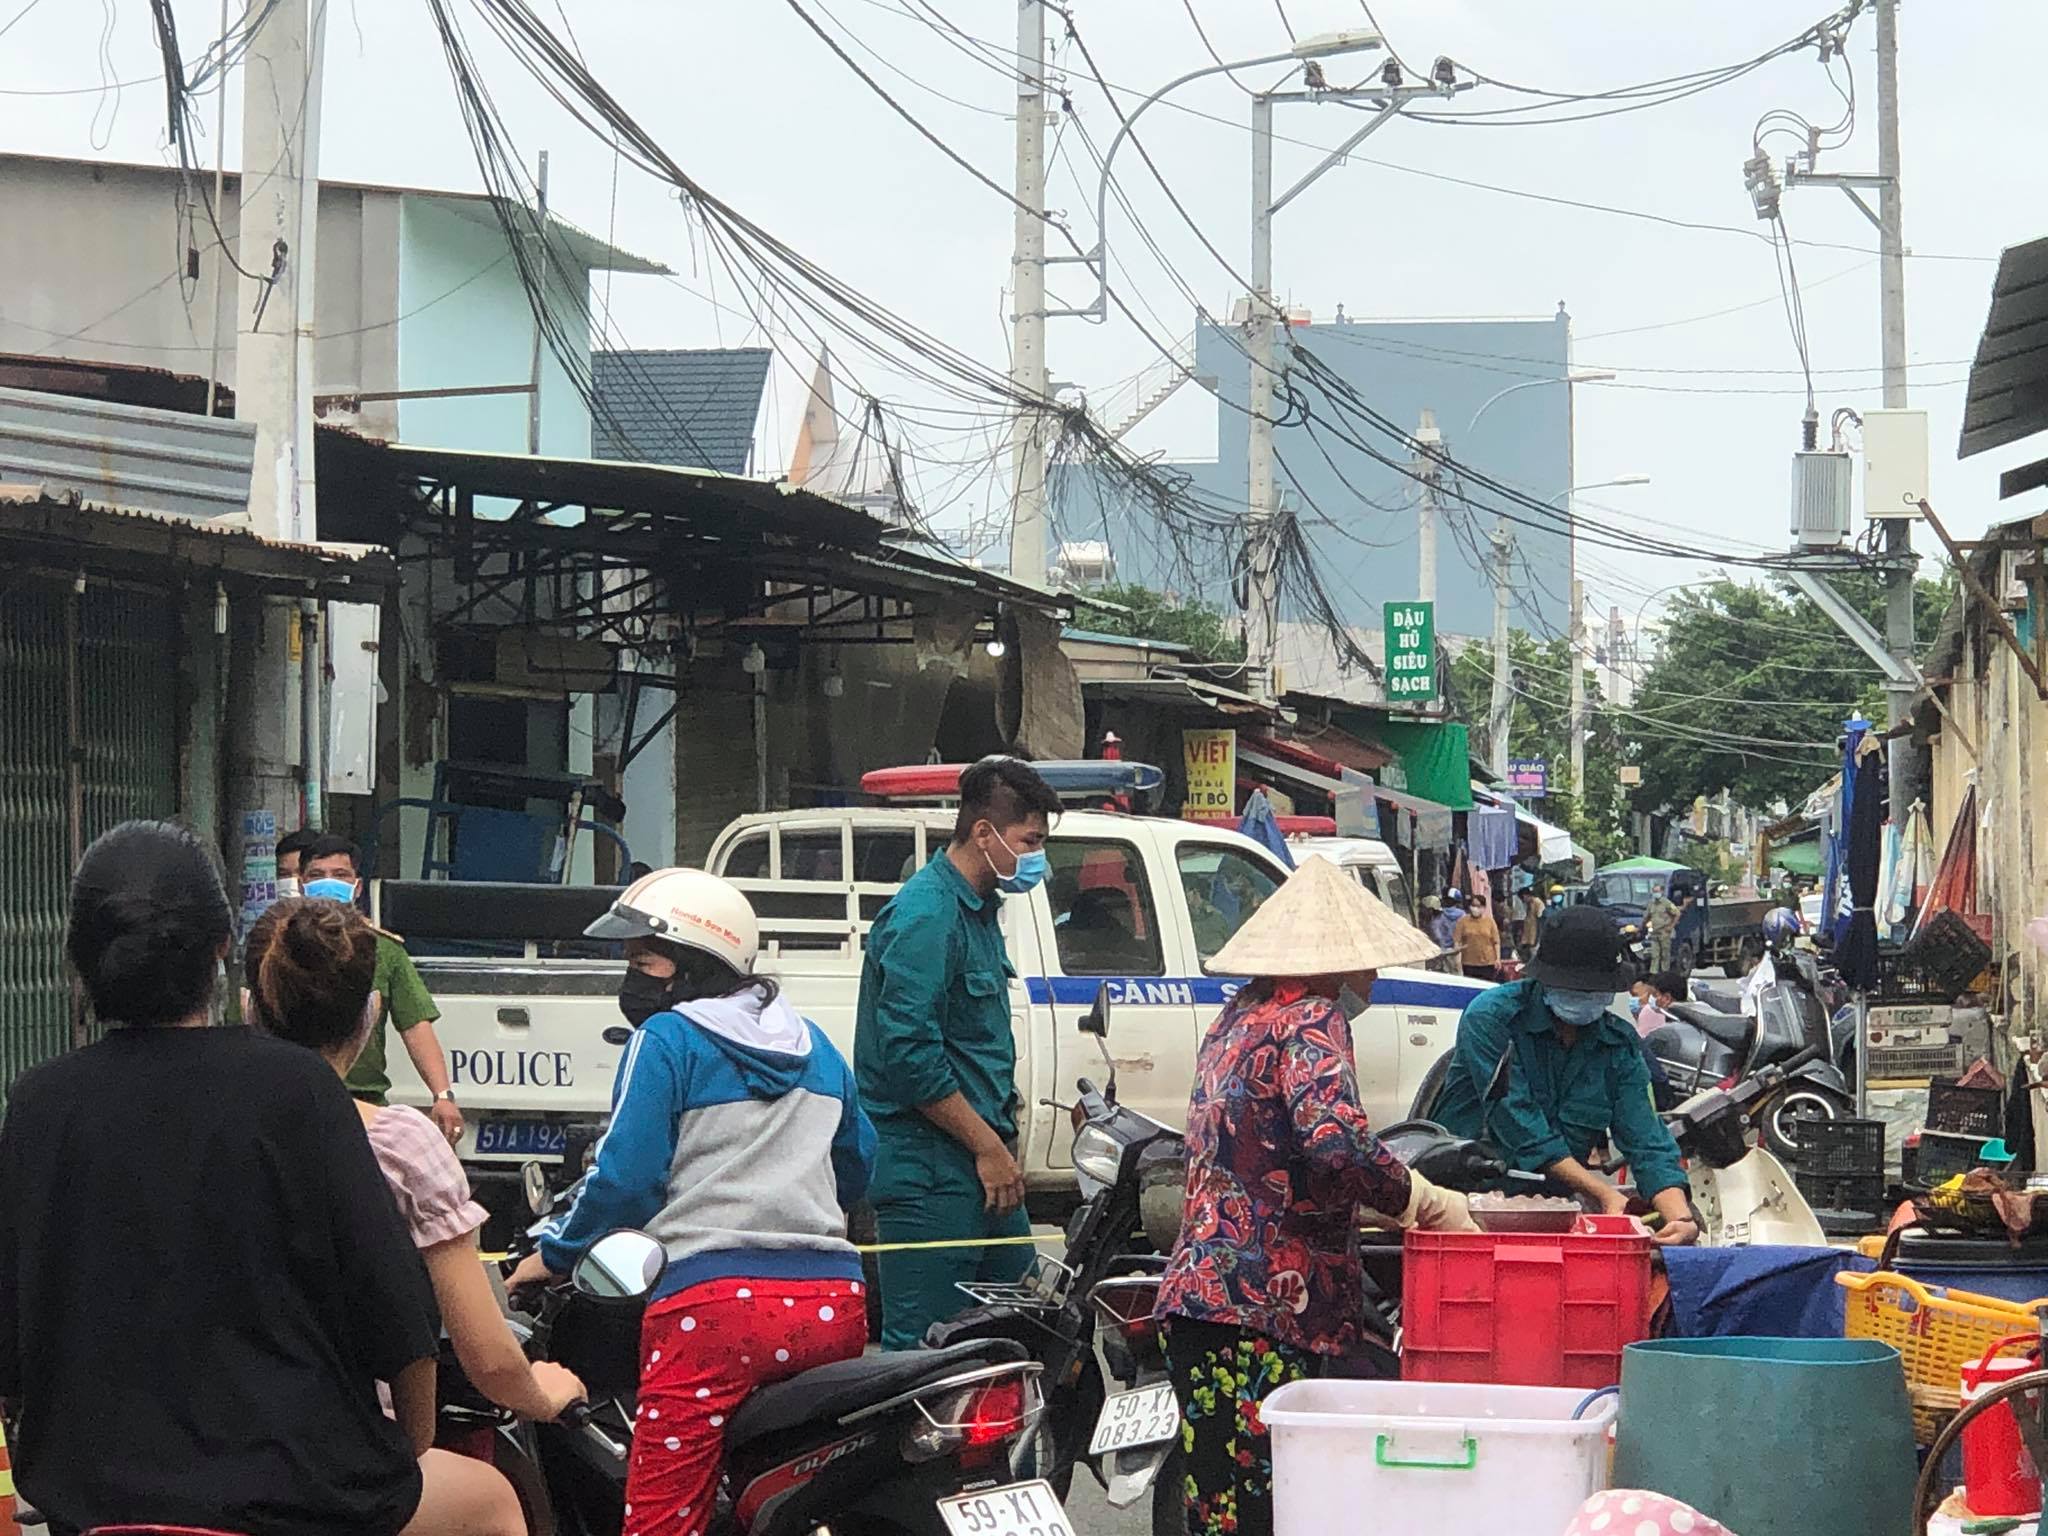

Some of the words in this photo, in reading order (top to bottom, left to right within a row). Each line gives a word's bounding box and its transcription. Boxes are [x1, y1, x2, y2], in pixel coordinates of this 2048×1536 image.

[1393, 651, 1427, 670] SIÊU
[1391, 676, 1430, 695] SẠCH
[450, 1049, 574, 1087] POLICE
[1113, 1388, 1173, 1421] 50-X1
[1098, 1412, 1175, 1449] 083.23
[957, 1490, 1042, 1532] 59-X1
